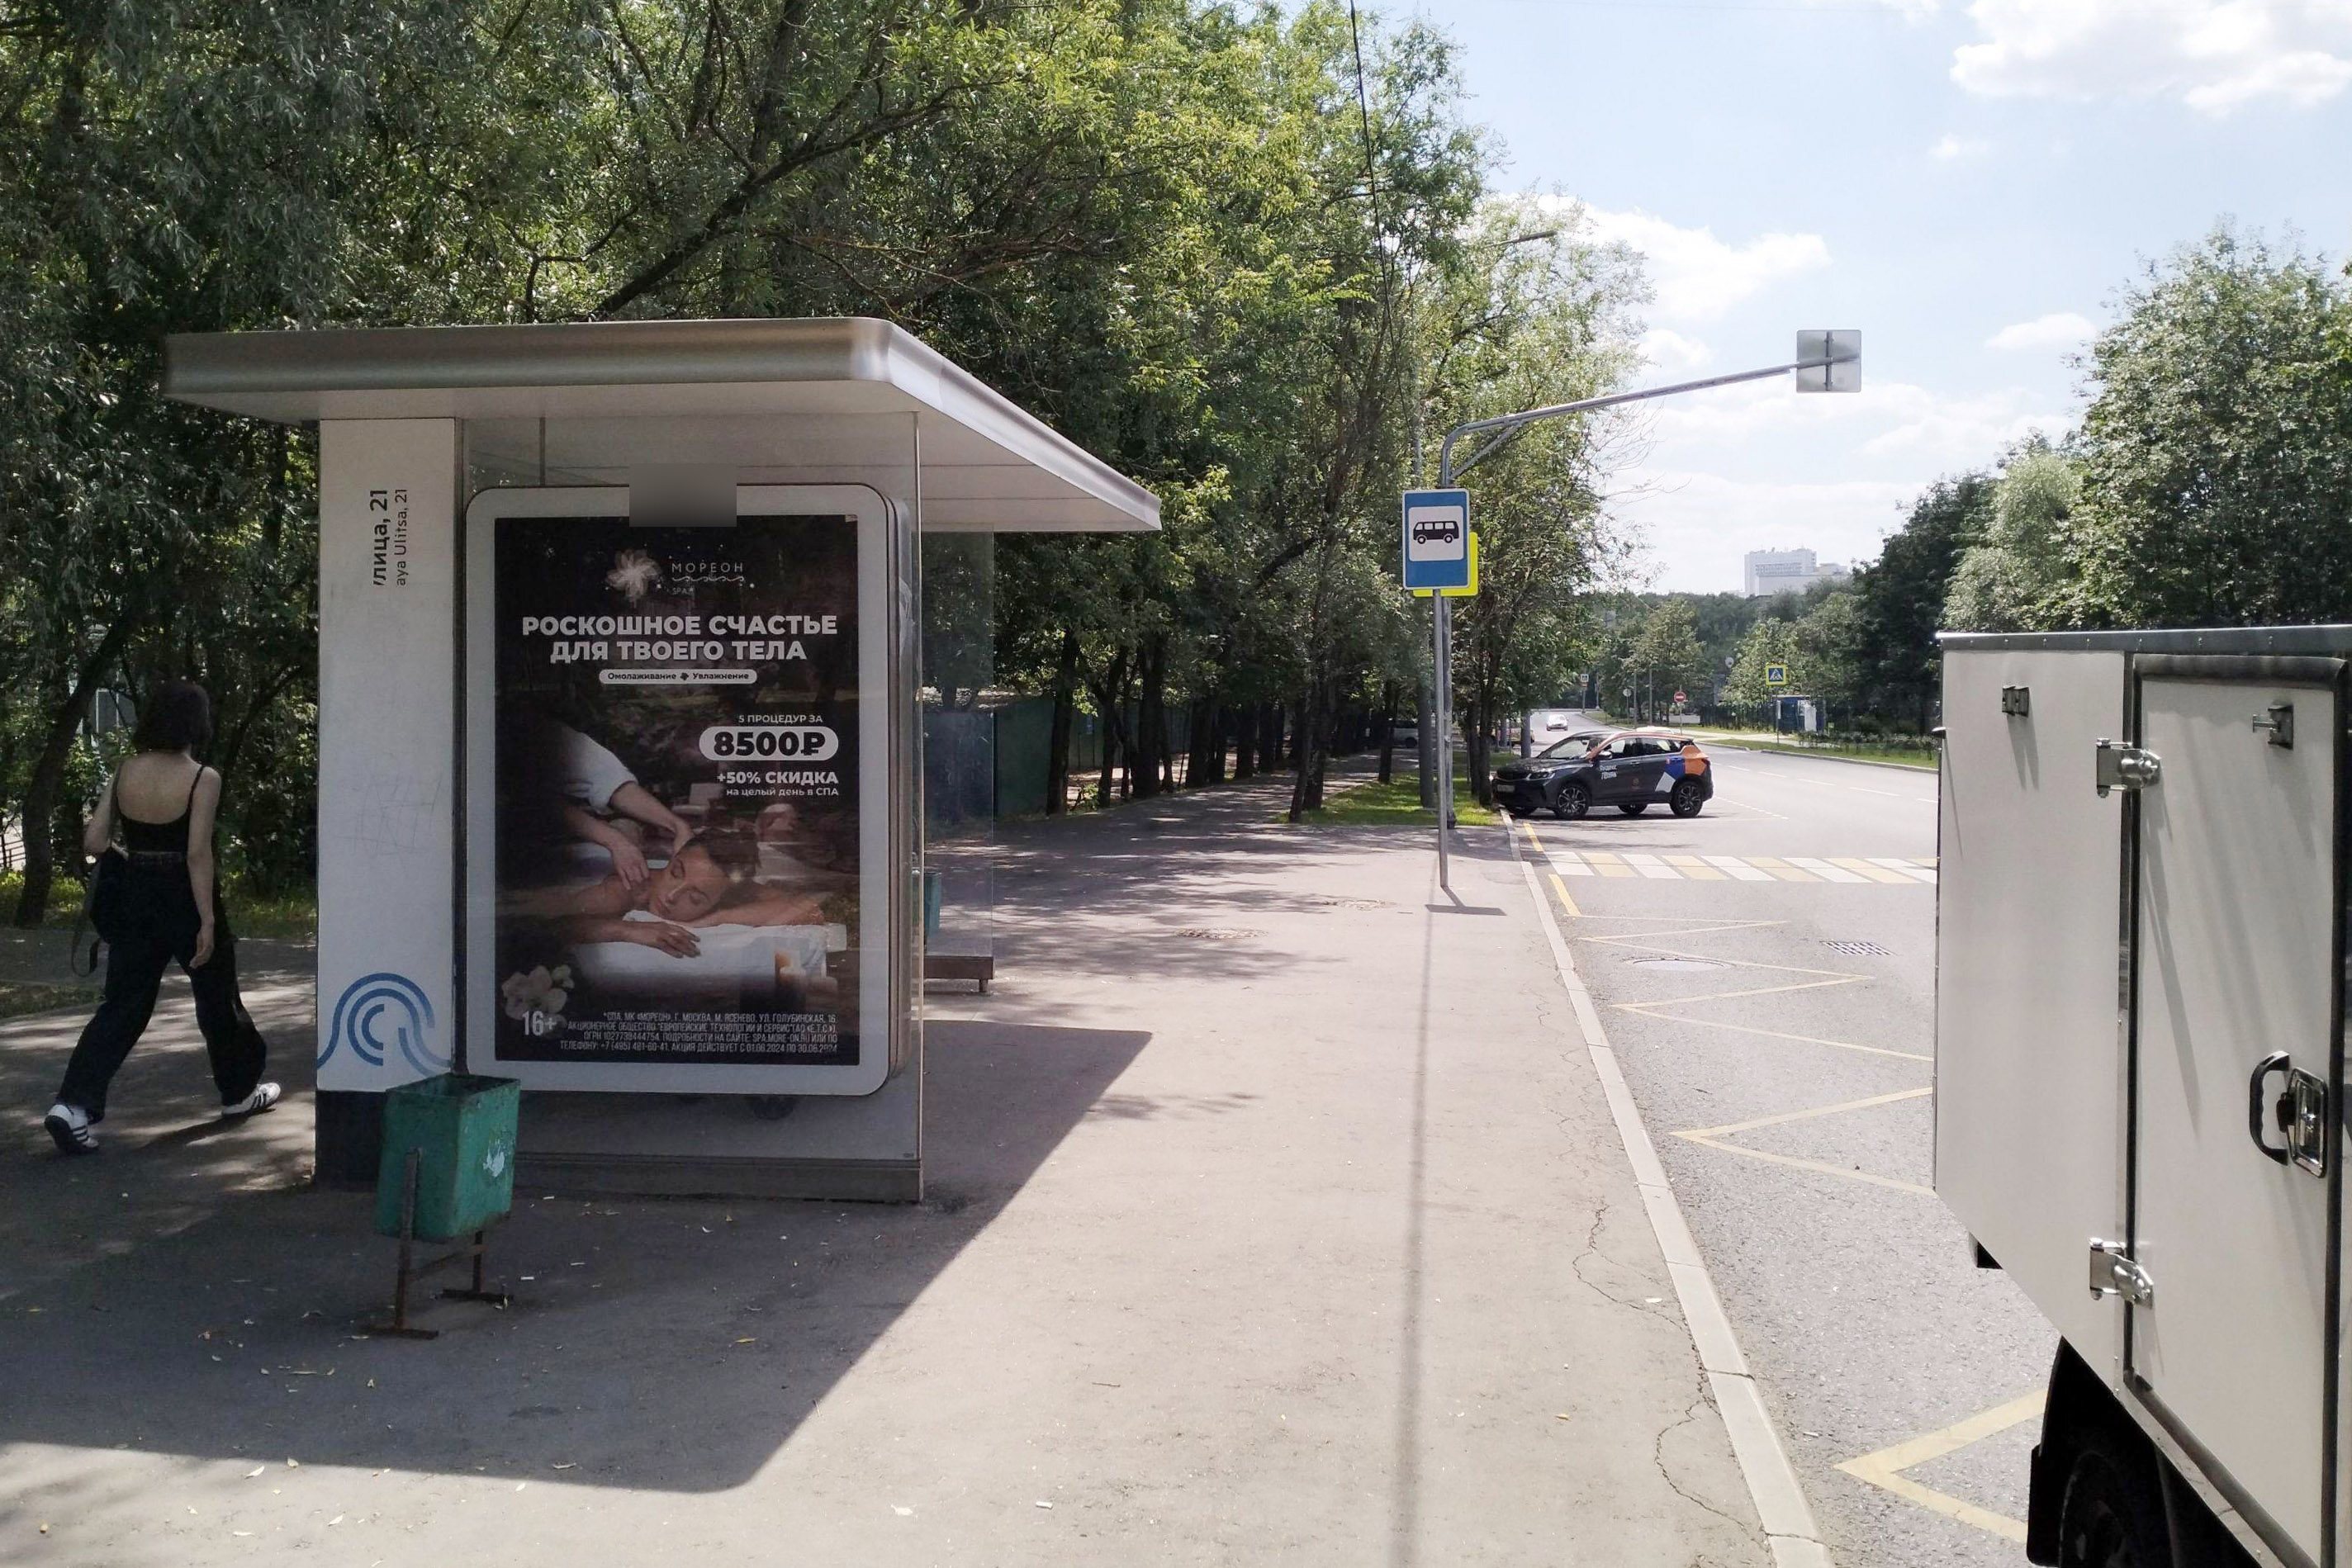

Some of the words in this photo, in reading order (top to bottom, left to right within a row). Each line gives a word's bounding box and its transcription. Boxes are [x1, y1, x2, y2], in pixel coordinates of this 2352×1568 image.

[369, 490, 388, 511] 21
[395, 490, 407, 503] 21
[394, 508, 409, 556] Ulitsa,
[671, 561, 743, 573] МОРЕОН
[522, 615, 701, 636] РОСКОШНОЕ
[709, 614, 837, 635] СЧАСТЬЕ
[550, 641, 609, 663] ДЛЯ
[617, 641, 724, 661] ТВОЕГО
[731, 640, 807, 660] ТЕЛА
[608, 671, 677, 680] Омолаживание
[692, 671, 749, 680] Увлажнение
[738, 715, 744, 723] 5
[747, 715, 807, 724] ПРОЦЕДУР
[809, 715, 823, 723] ЗА
[714, 731, 826, 756] 8500₽
[717, 771, 761, 784] +50%
[765, 771, 839, 786] СКИДКА
[742, 788, 776, 798] целый
[779, 789, 805, 797] день
[815, 788, 839, 796] СПА
[522, 1011, 557, 1036] 16+
